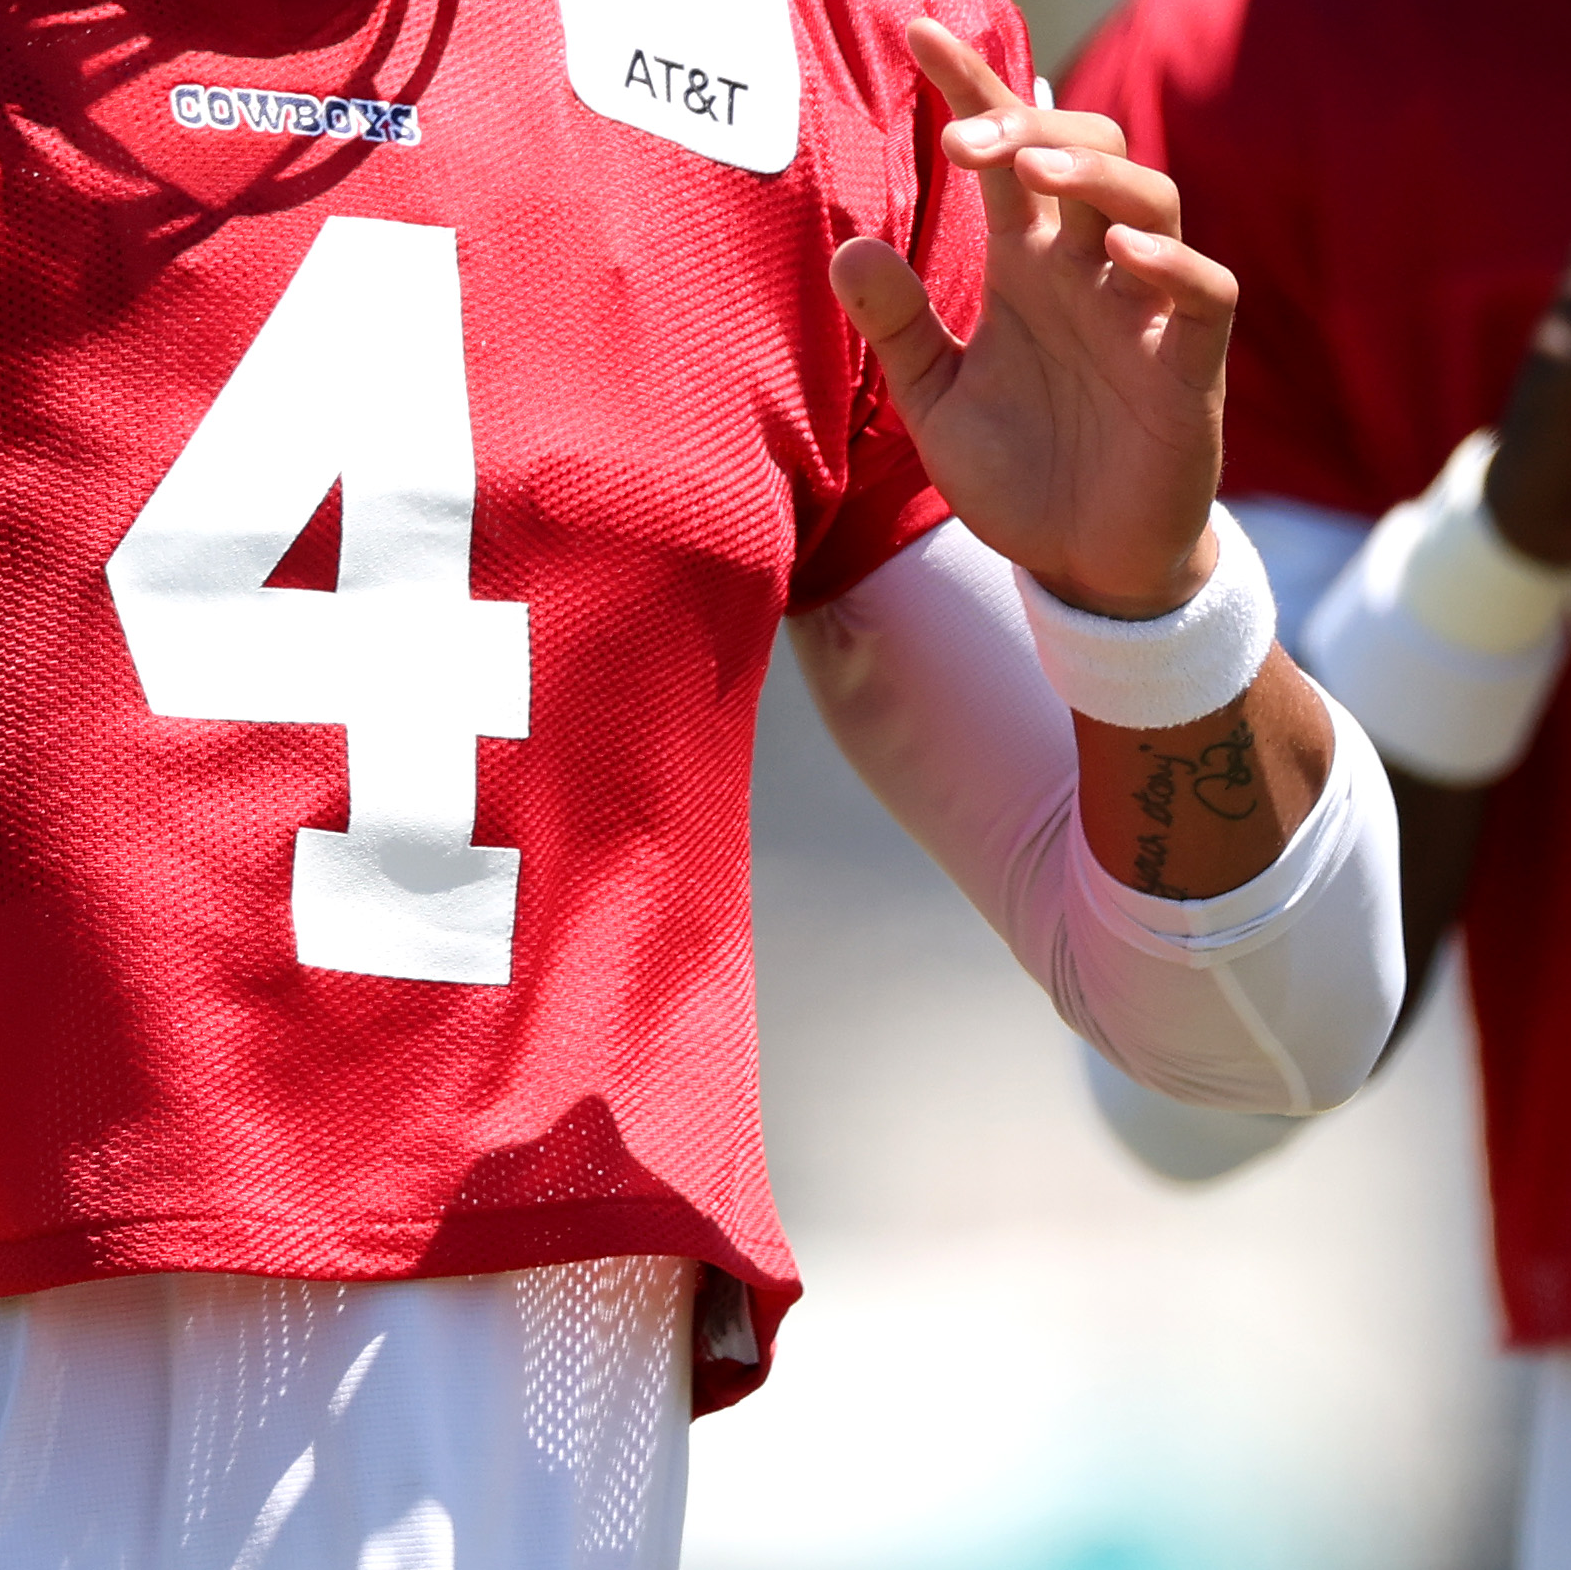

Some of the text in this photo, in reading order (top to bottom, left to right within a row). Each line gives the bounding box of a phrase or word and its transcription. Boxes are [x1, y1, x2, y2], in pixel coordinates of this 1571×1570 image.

[172, 86, 420, 144] COWBOYS
[625, 48, 749, 126] AT&T
[105, 215, 531, 986] 4
